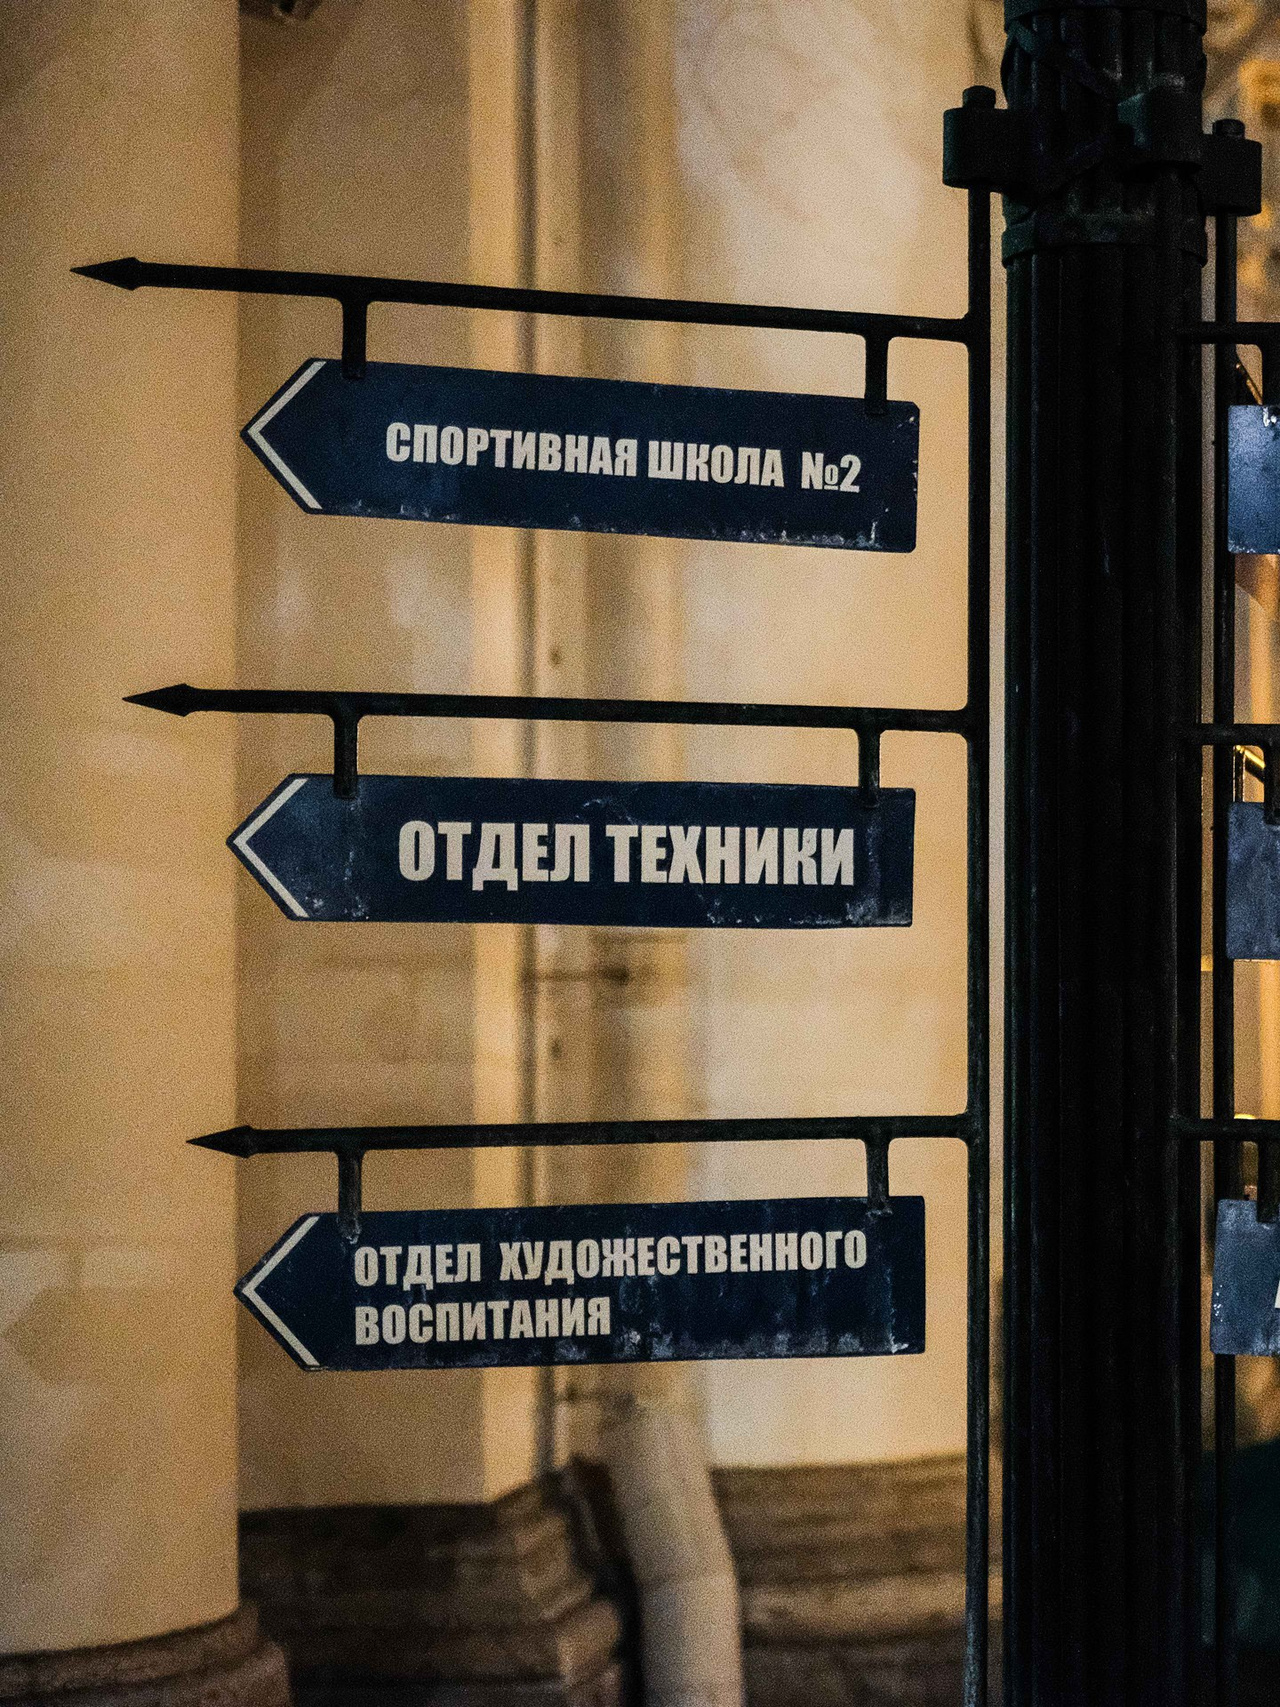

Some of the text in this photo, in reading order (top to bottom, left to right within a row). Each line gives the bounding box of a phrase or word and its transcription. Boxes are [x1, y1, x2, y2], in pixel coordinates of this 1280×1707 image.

[386, 421, 862, 494] СПОРТИВНАЯ ШКОЛА №2
[398, 820, 856, 891] ОТДЕЛ ТЕХНИКИ
[354, 1229, 868, 1291] ОТДЕЛ ХУДОЖЕСТВЕННОГО
[354, 1296, 612, 1345] ВОСПИТАНИЯ
